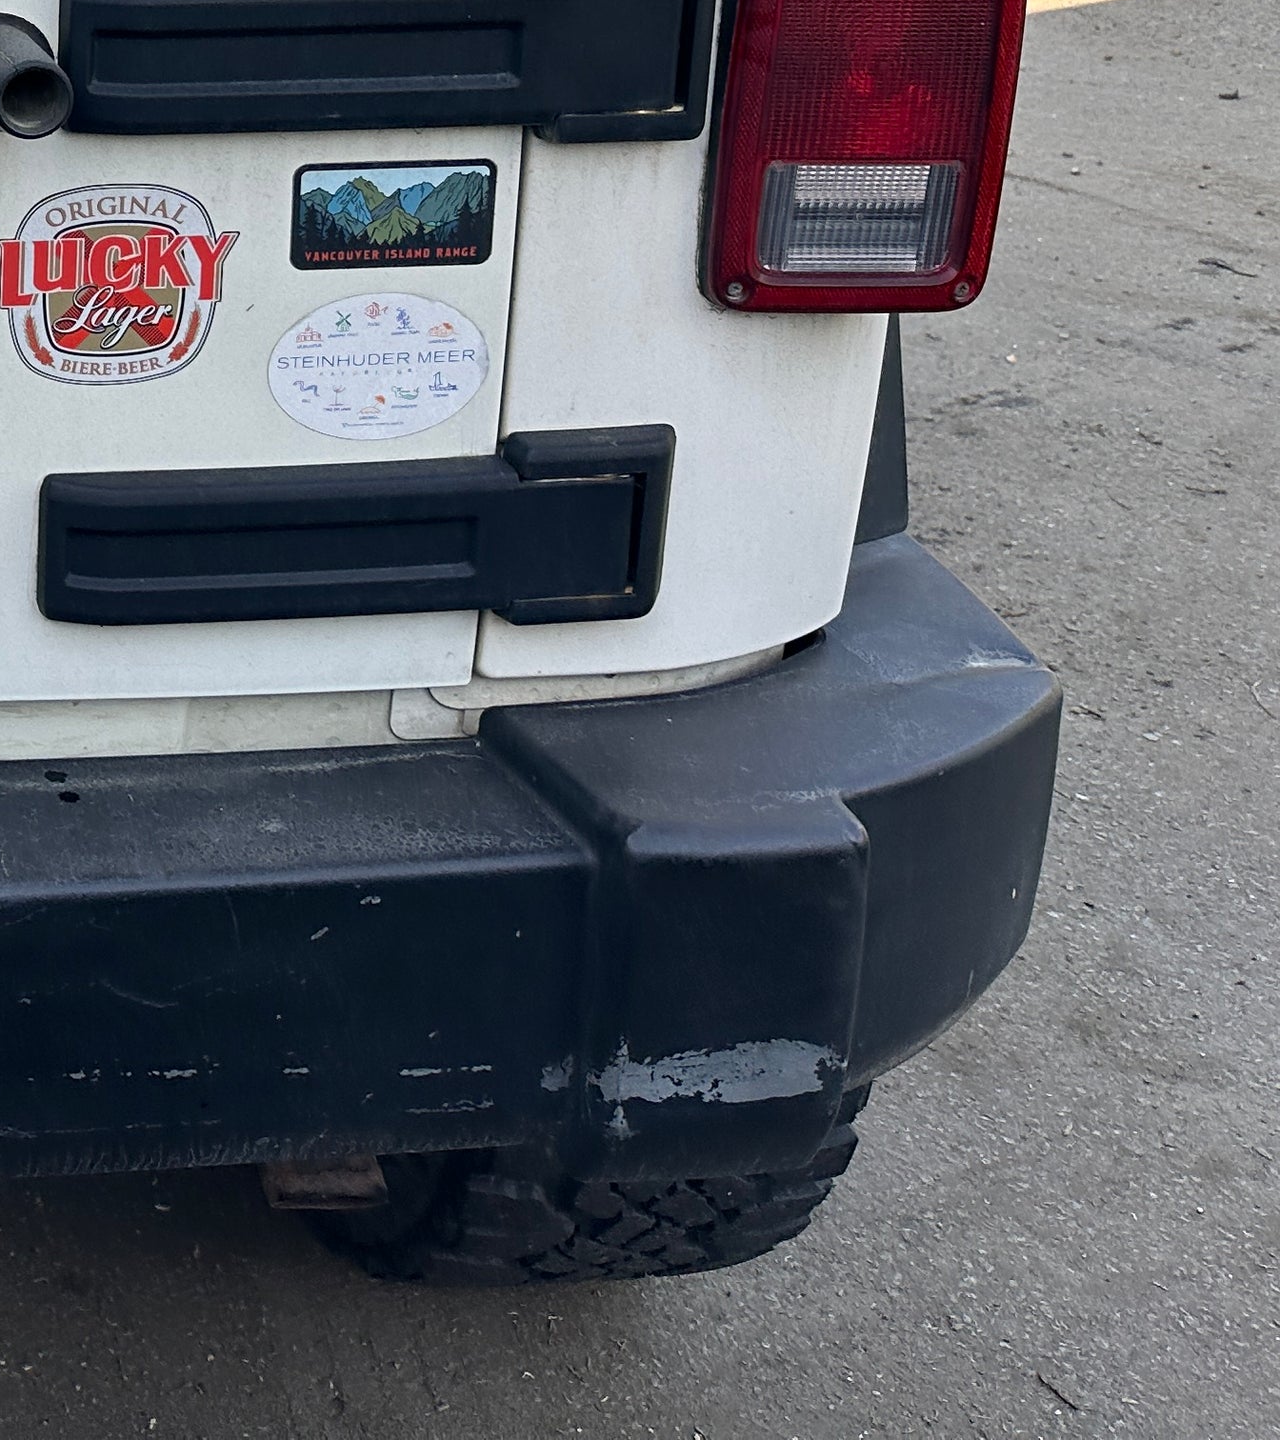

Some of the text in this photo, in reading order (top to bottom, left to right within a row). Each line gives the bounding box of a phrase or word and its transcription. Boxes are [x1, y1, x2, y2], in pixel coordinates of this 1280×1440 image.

[45, 196, 188, 227] ORIGINAL
[304, 246, 478, 262] VANCOUVER ISLAND RANGE
[53, 285, 173, 349] Lager
[276, 349, 476, 370] STEINHUDER MEER
